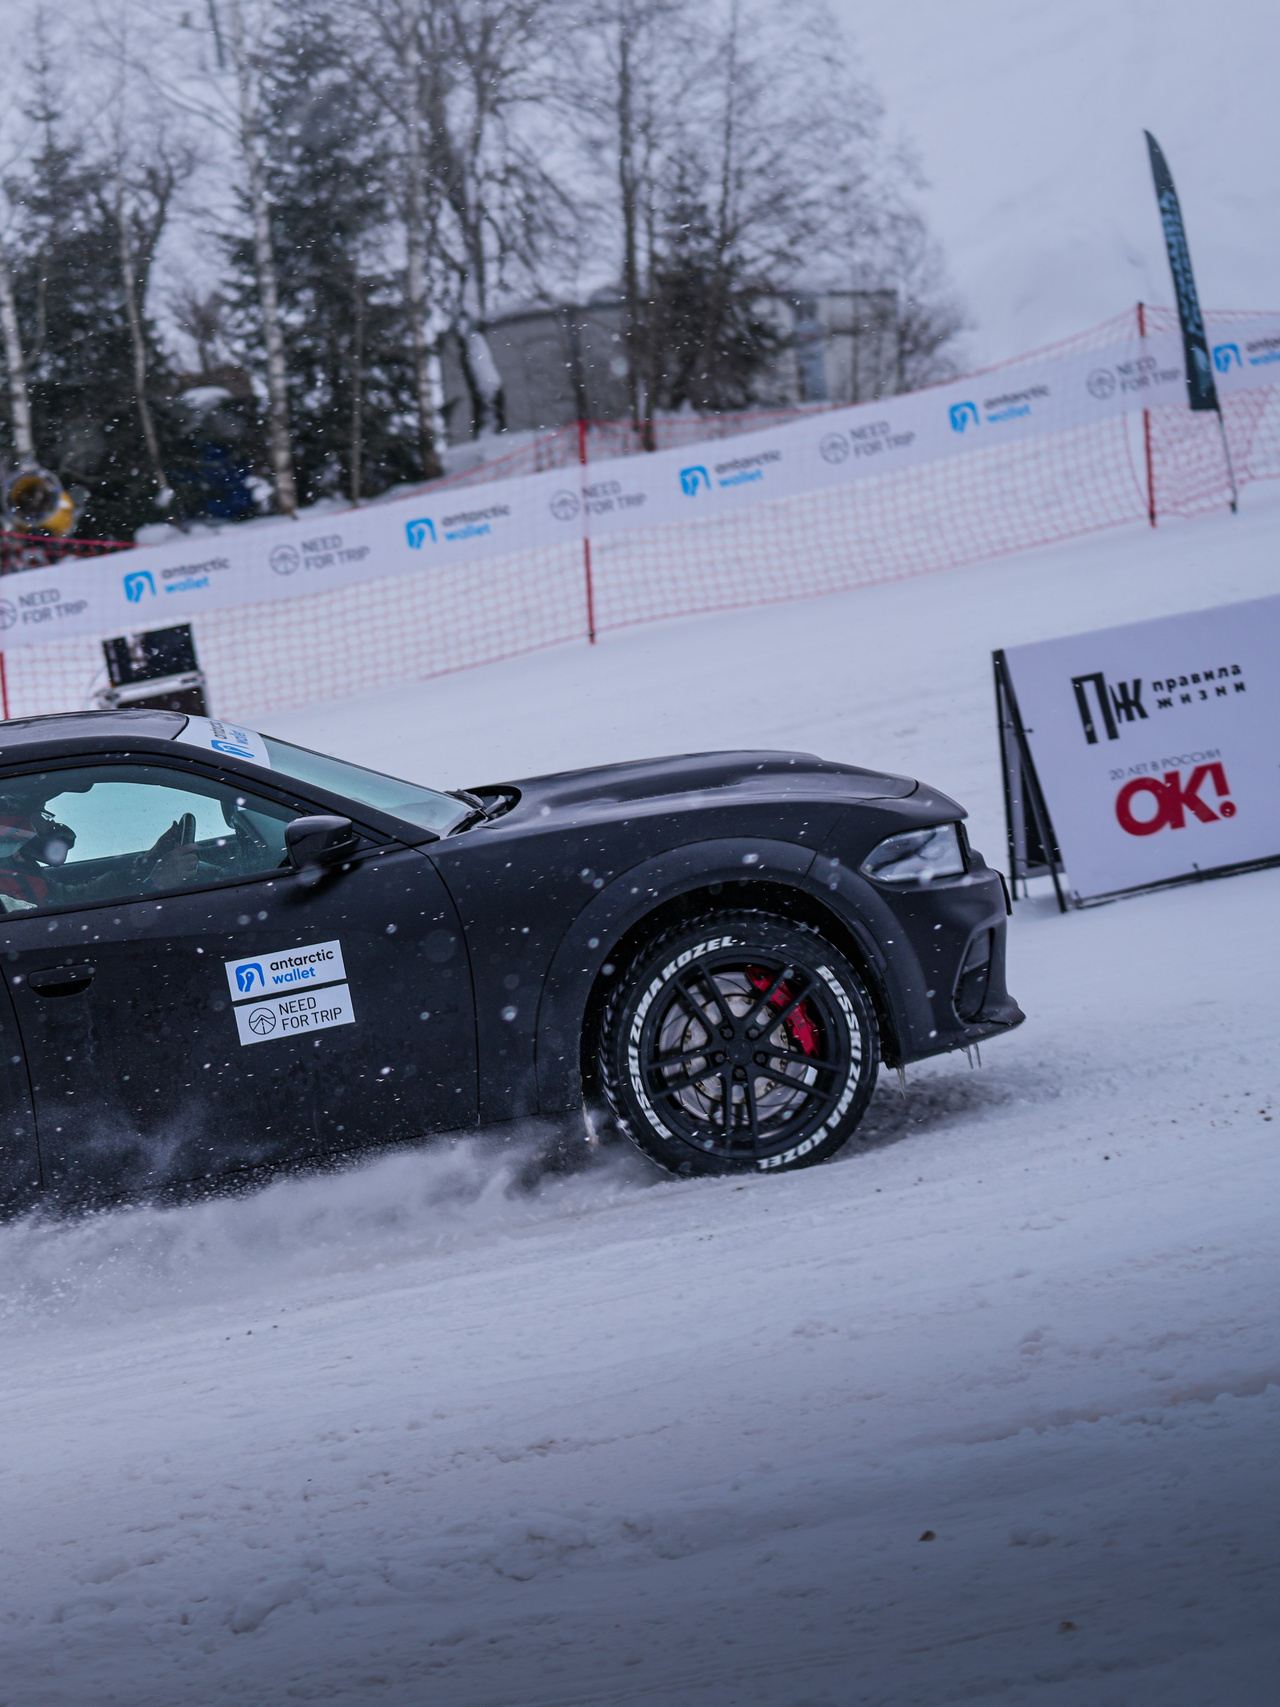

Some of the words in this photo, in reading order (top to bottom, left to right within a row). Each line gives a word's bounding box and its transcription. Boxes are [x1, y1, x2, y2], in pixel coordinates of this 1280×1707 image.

[1116, 356, 1157, 375] NEED
[986, 404, 1031, 424] wallet
[850, 421, 890, 440] NEED
[854, 439, 883, 457] FOR
[886, 431, 916, 450] TRIP
[581, 480, 621, 498] NEED
[719, 469, 763, 487] wallet
[442, 504, 511, 527] antarctic
[302, 535, 343, 553] NEED
[445, 523, 491, 542] wallet
[161, 556, 231, 580] antarctic
[305, 552, 337, 571] FOR
[338, 545, 371, 563] TRIP
[164, 575, 211, 593] wallet
[18, 588, 61, 607] NEED
[22, 606, 53, 625] FOR
[56, 599, 89, 618] TRIP
[1152, 664, 1242, 693] правила
[270, 949, 335, 971] antarctic
[661, 935, 734, 981] KOZEL
[272, 967, 316, 985] wallet
[278, 997, 317, 1015] NEED
[630, 977, 664, 1042] ZIMA
[816, 965, 862, 1060] RUSSKI
[281, 1014, 310, 1031] FOR
[311, 1007, 342, 1024] TRIP
[628, 1046, 673, 1140] RUSSKI
[826, 1063, 861, 1129] ZIMA
[756, 1126, 828, 1170] KOZEL
